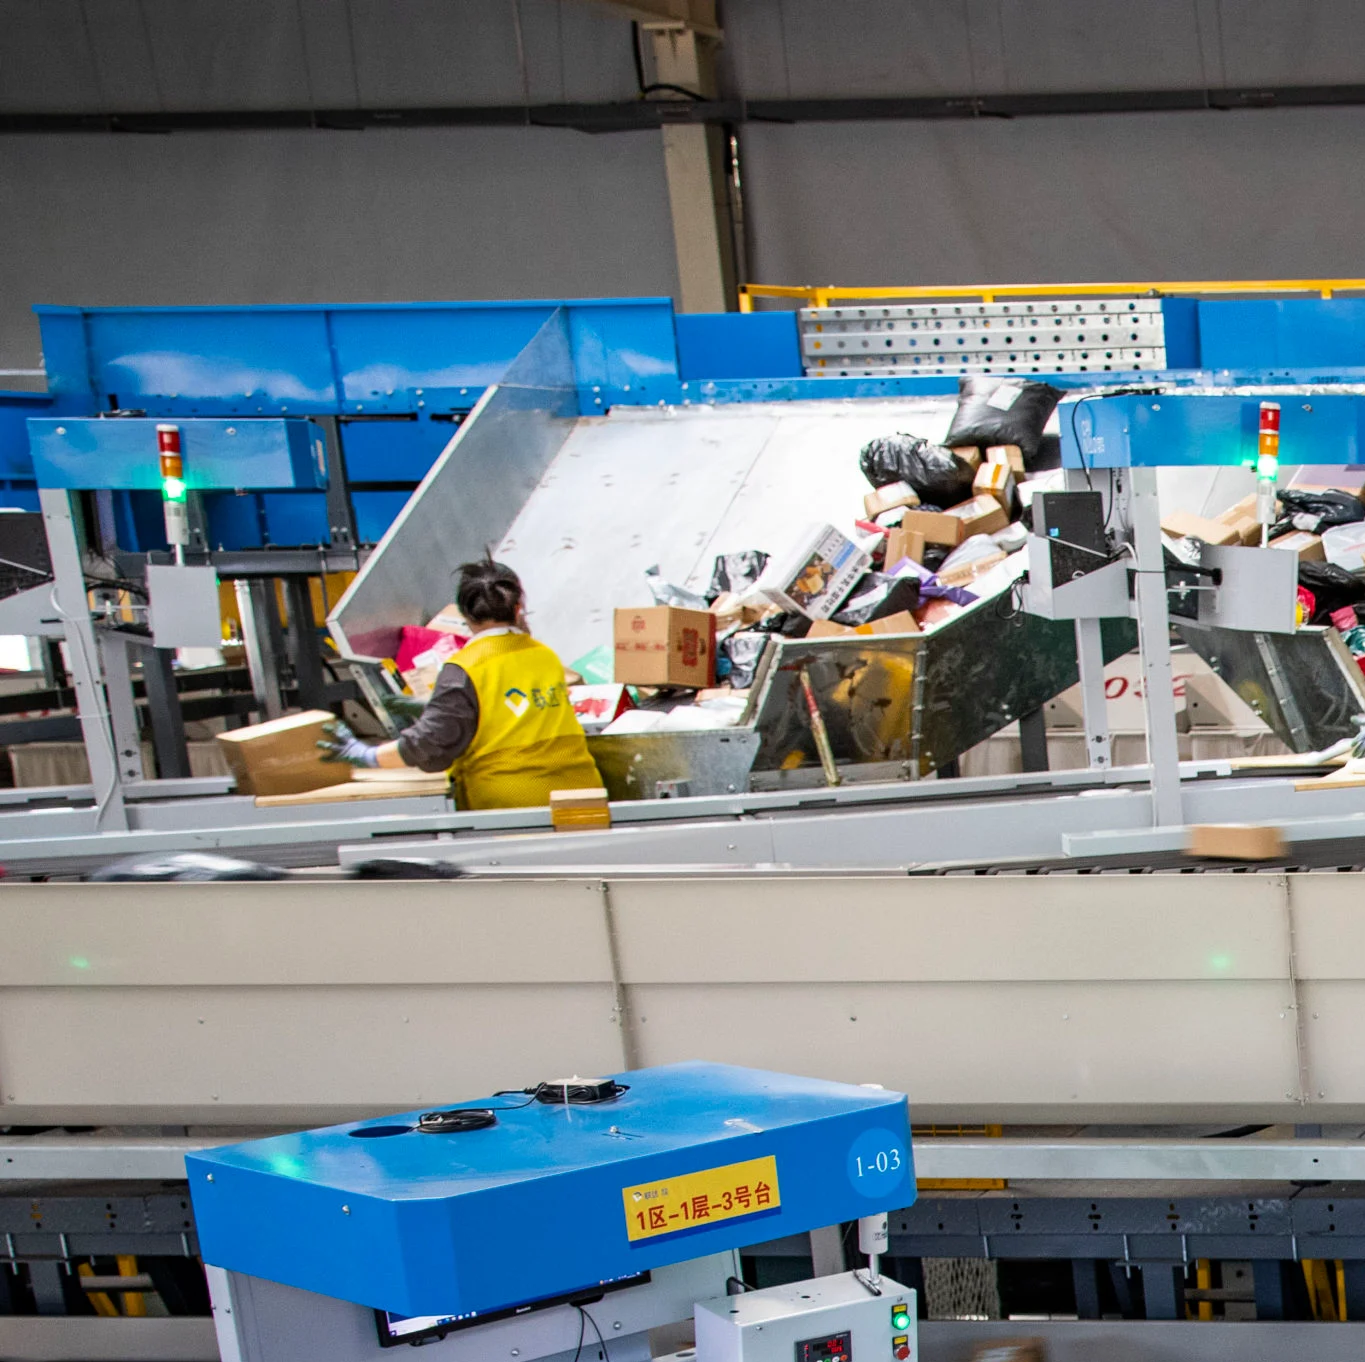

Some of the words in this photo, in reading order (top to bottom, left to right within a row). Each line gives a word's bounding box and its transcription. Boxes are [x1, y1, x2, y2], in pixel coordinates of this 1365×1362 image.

[855, 1148, 901, 1178] 1-03
[636, 1181, 771, 1231] 1区-1层-3号台
